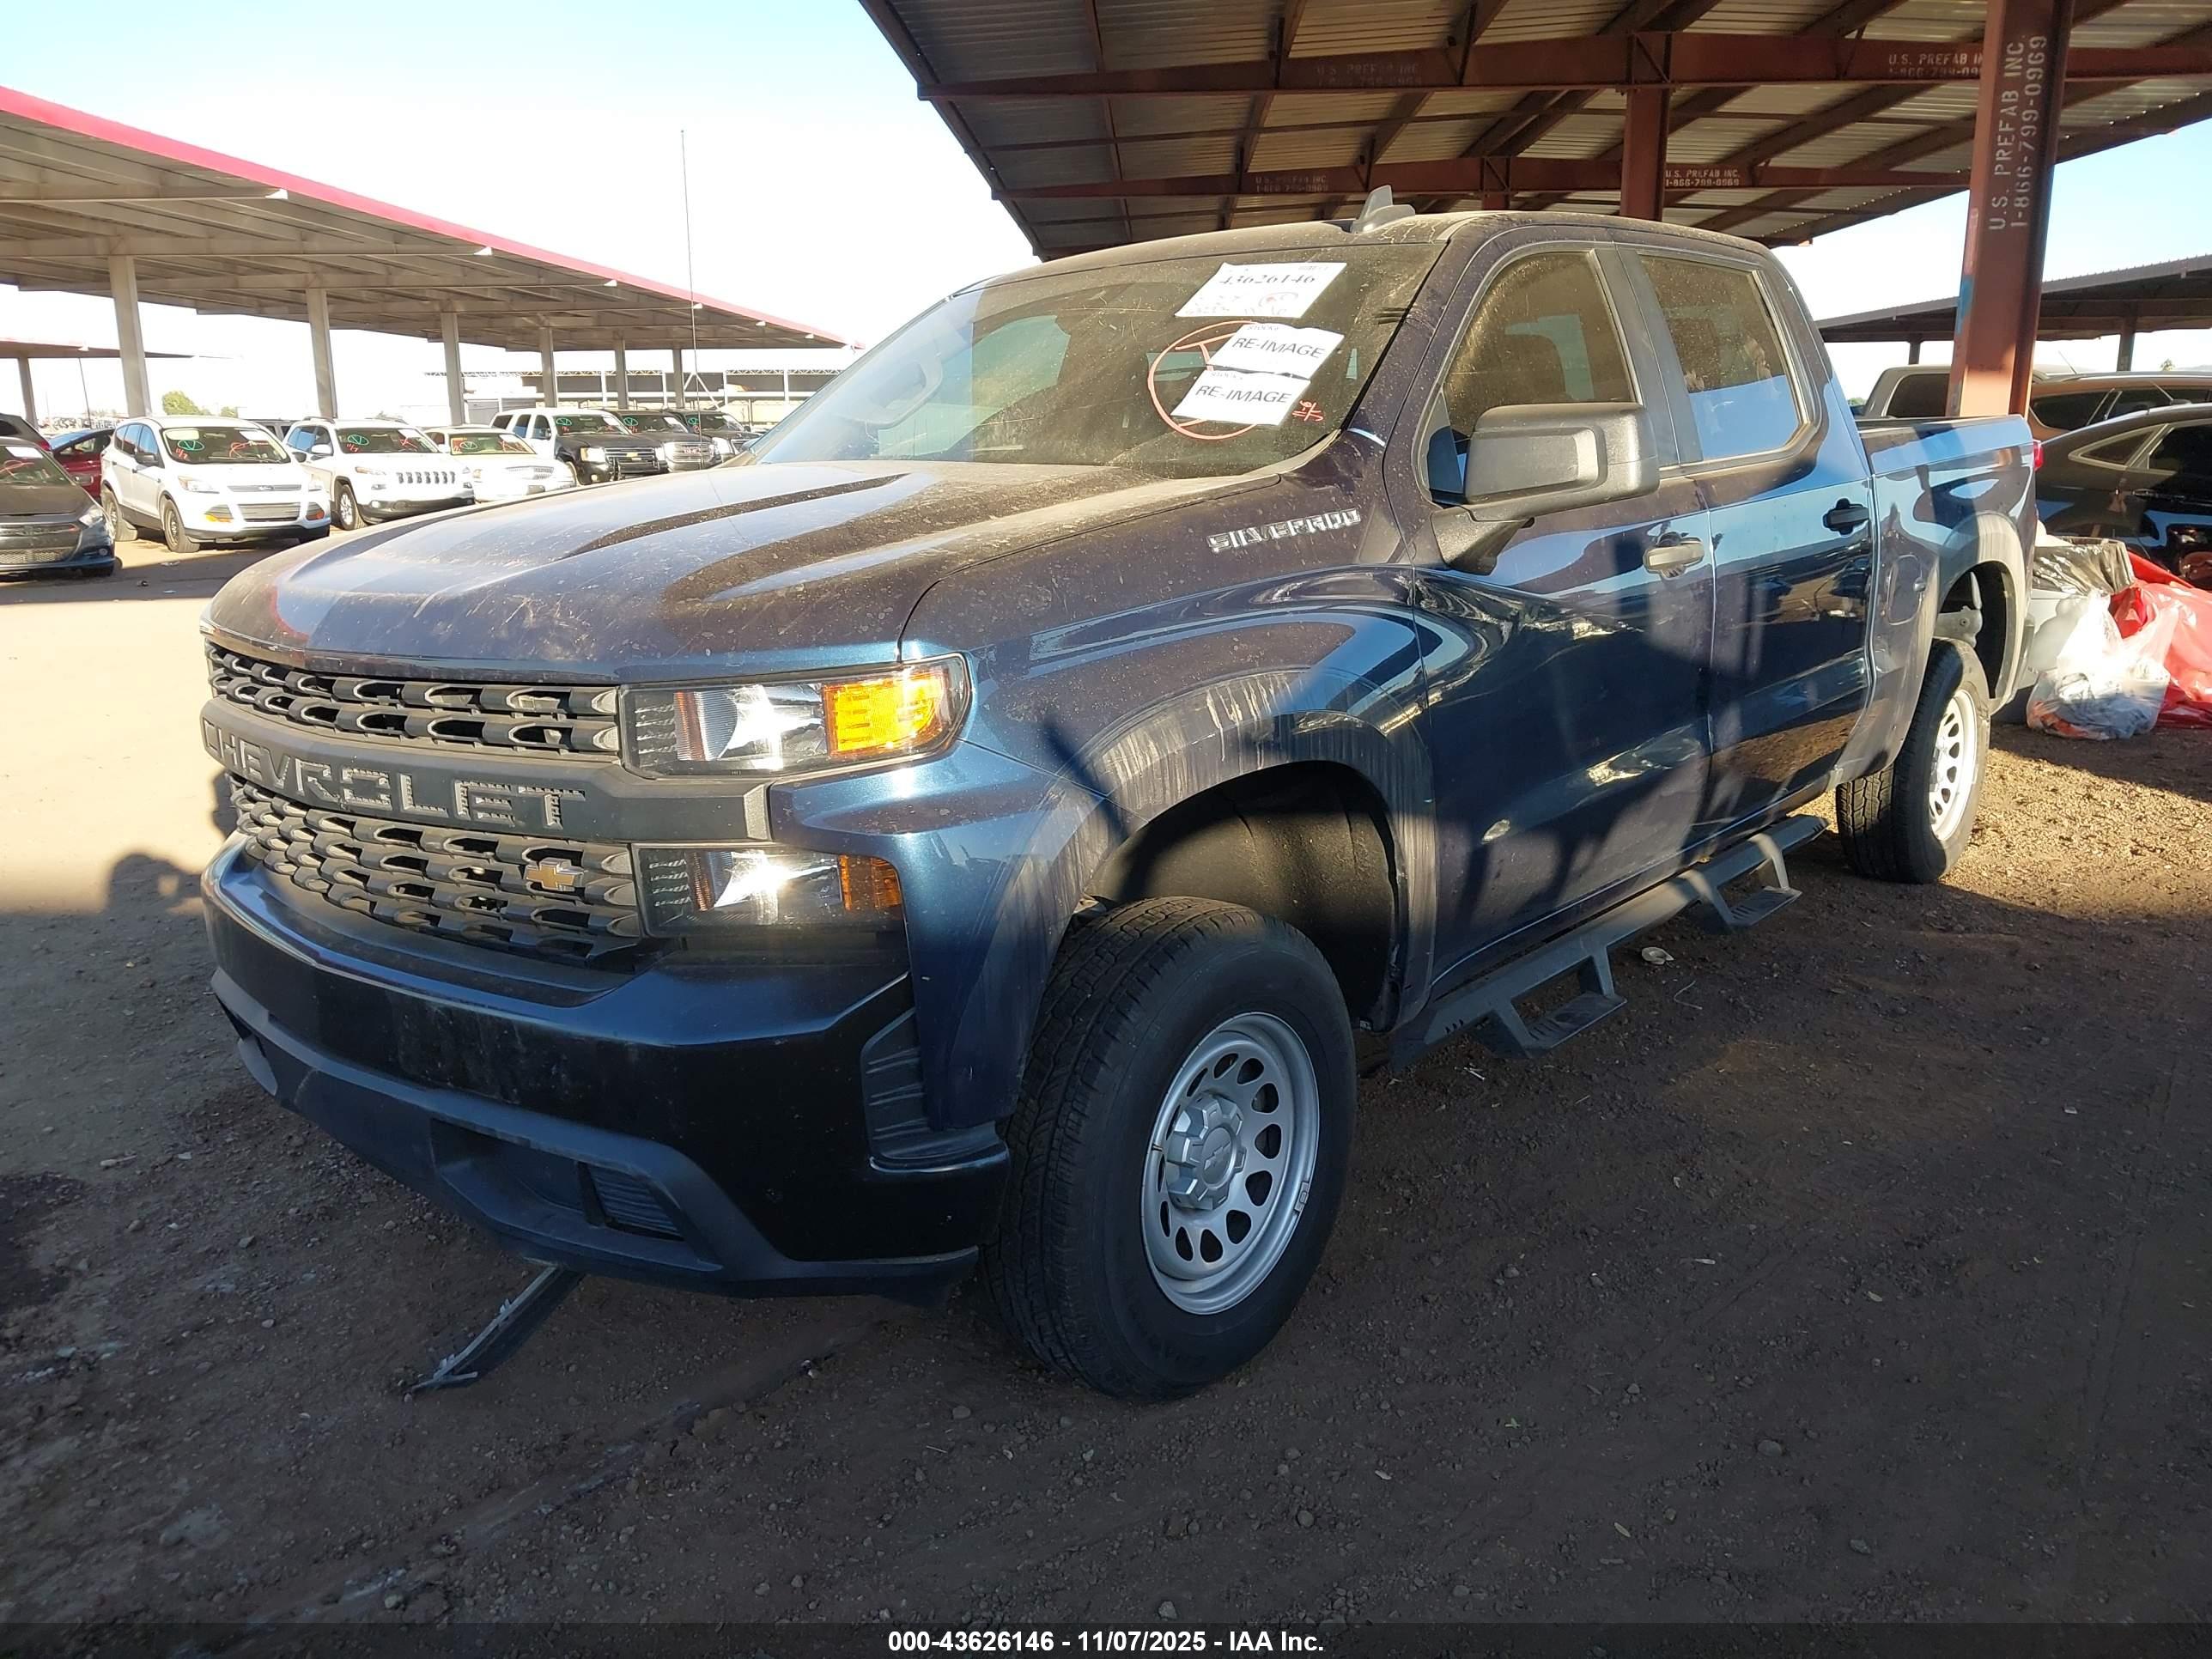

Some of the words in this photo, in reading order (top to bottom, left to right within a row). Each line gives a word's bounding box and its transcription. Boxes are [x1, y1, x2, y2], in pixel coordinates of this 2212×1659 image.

[1888, 53, 1912, 65] U.S.
[1919, 52, 1968, 65] PREFAB
[2003, 34, 2026, 78] INC.
[1994, 89, 2020, 176] PREFAB
[2010, 35, 2048, 228] 1-866-799-0969
[1686, 168, 1721, 178] PREFAB
[1988, 190, 2010, 230] U.S.
[1231, 337, 1325, 359] RE-IMAGE
[1194, 384, 1292, 404] RE-IMAGE
[1206, 507, 1362, 553] SILVERADO
[204, 720, 586, 830] CHEVROLET
